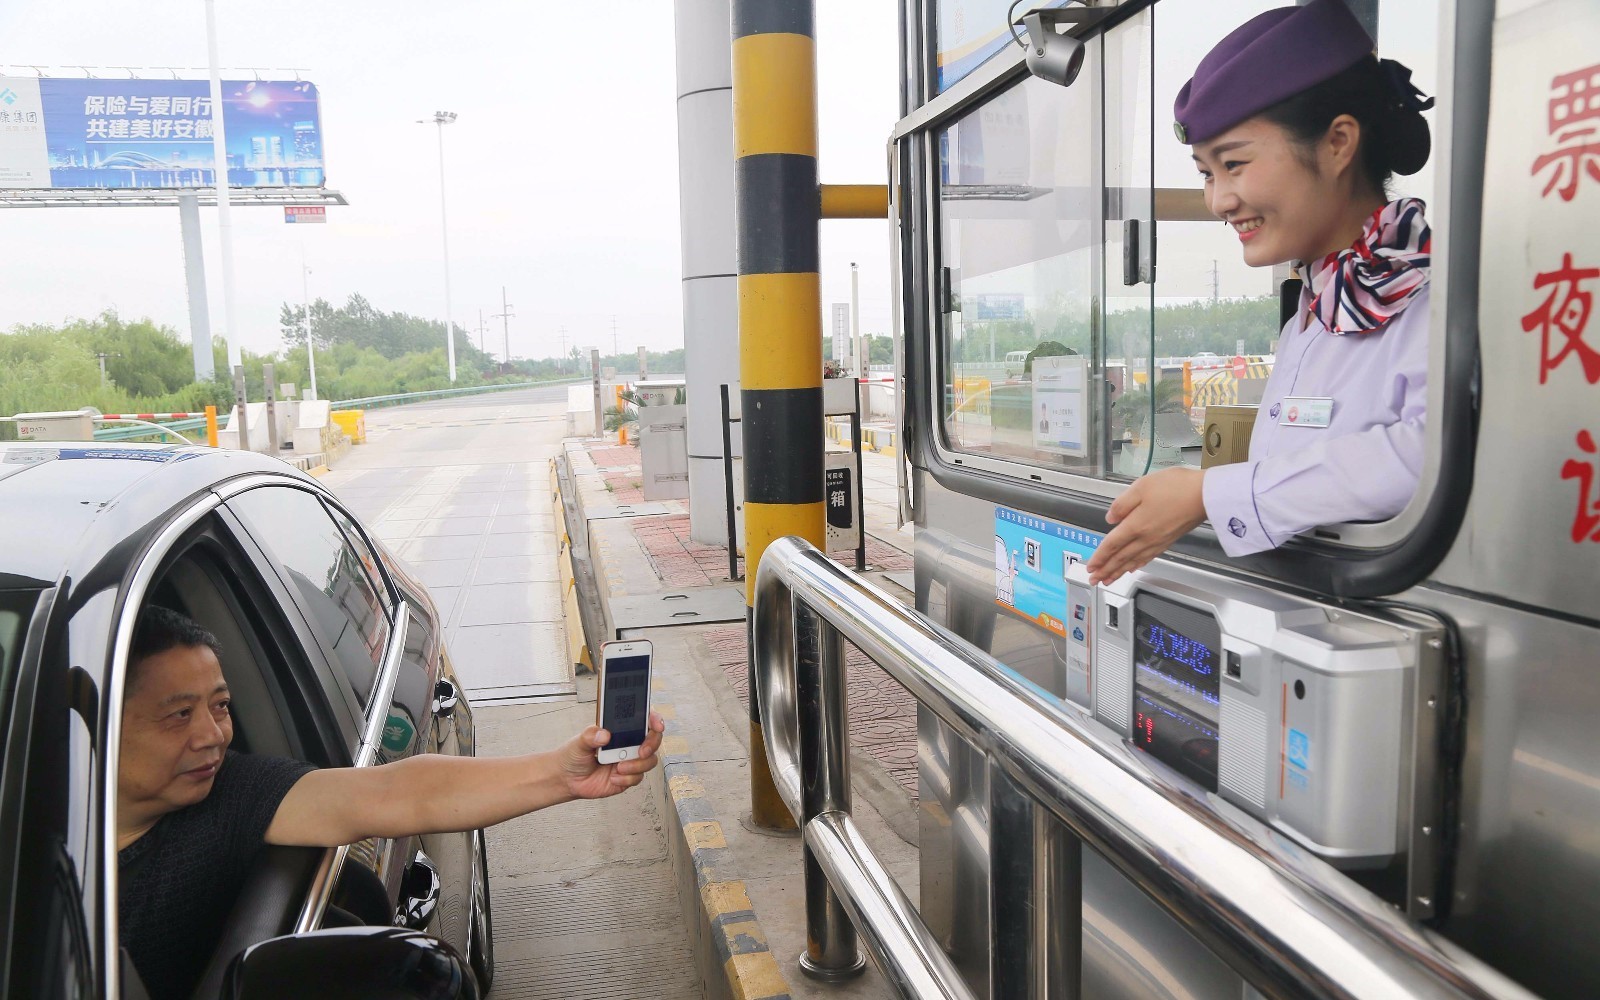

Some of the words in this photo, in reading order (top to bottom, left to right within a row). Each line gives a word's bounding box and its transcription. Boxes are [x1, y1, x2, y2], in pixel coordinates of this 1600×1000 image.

[84, 96, 212, 115] 保险与爱同行
[86, 119, 214, 138] 共建美好安徽
[831, 490, 845, 507] 箱
